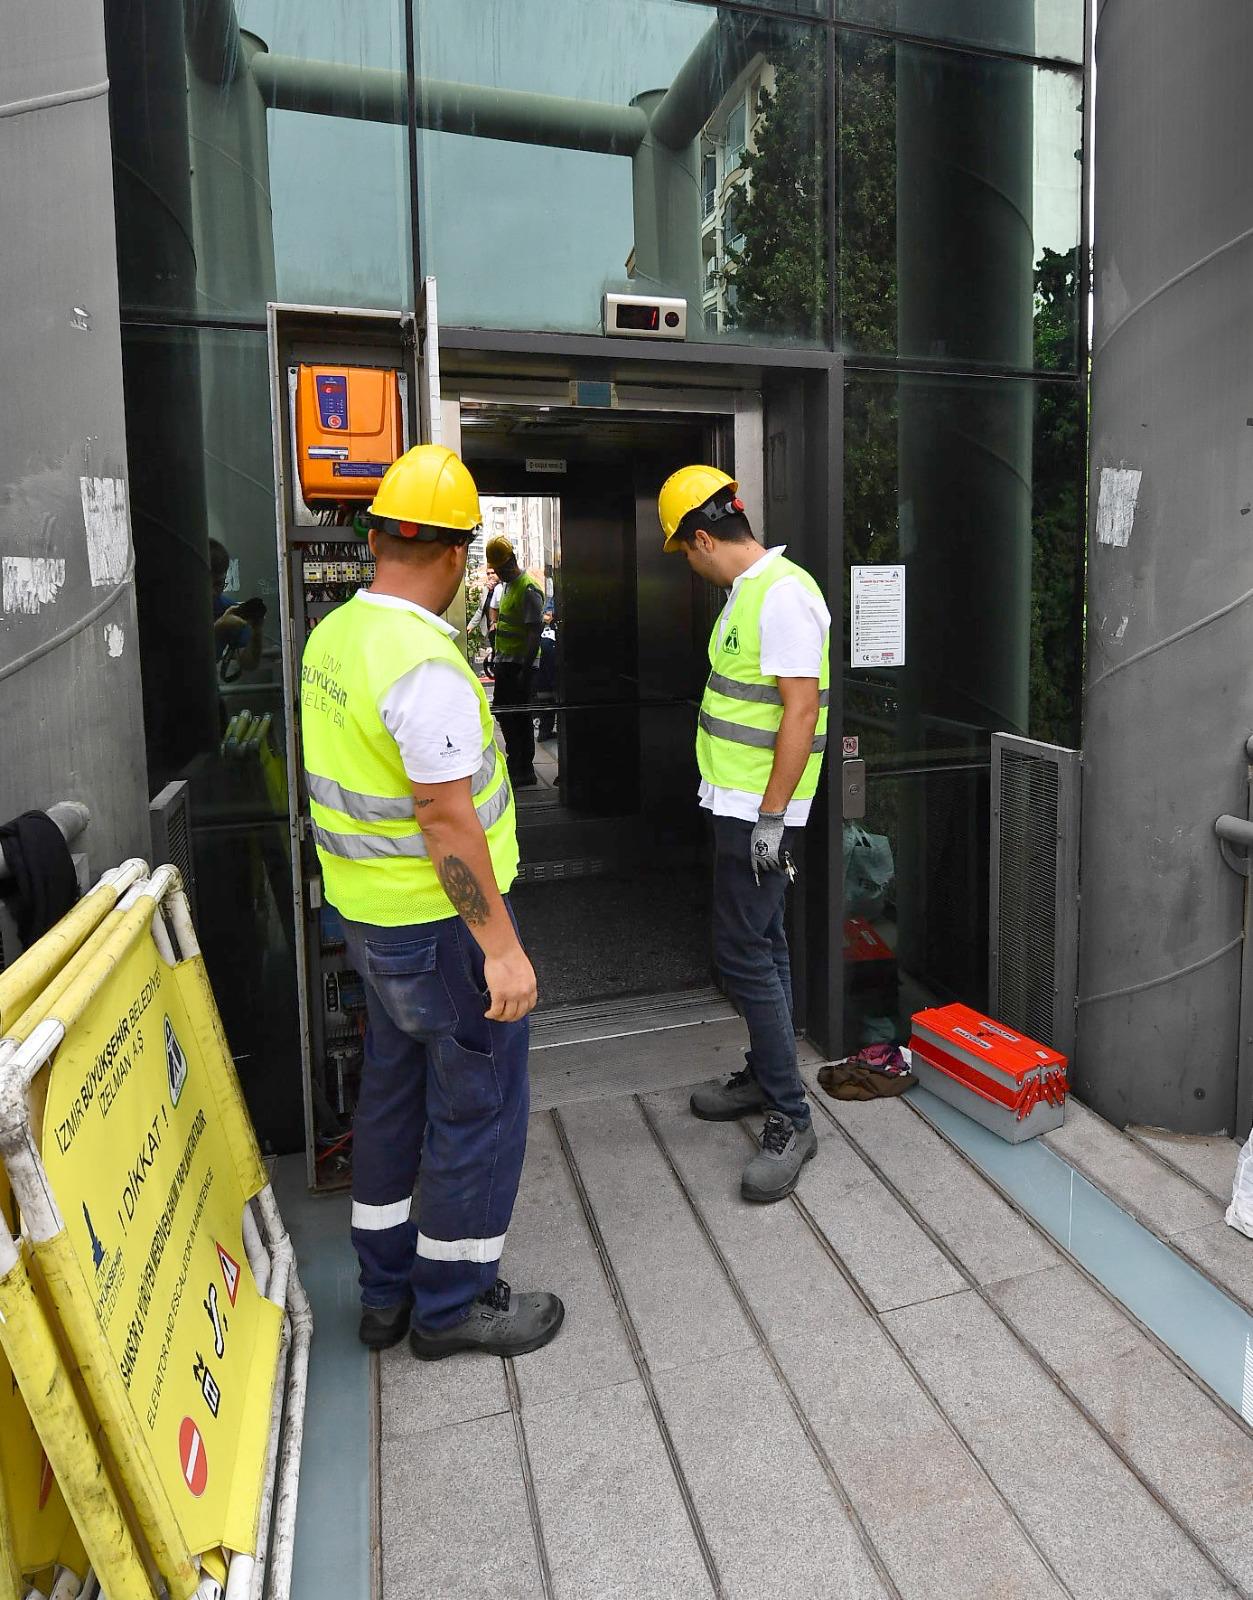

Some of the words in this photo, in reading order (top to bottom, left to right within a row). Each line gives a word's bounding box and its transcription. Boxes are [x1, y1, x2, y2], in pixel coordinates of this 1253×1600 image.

[54, 1099, 84, 1156] İZMİR
[81, 1017, 130, 1111] BÜYÜKŞEHİR
[97, 1052, 132, 1120] İZELMAN
[161, 1104, 169, 1128] !
[122, 1114, 161, 1222] DİKKAT
[118, 1209, 128, 1237] !
[150, 1207, 173, 1272] MERDİVEN
[102, 1264, 126, 1330] ELEDİYESİ
[135, 1310, 144, 1335] &
[137, 1257, 156, 1322] YÜRÜYEN
[120, 1320, 142, 1392] SANSÖR
[147, 1343, 169, 1430] ELEVATOR
[165, 1312, 175, 1350] AND
[171, 1239, 192, 1317] ESCALATOR
[189, 1223, 196, 1245] IN
